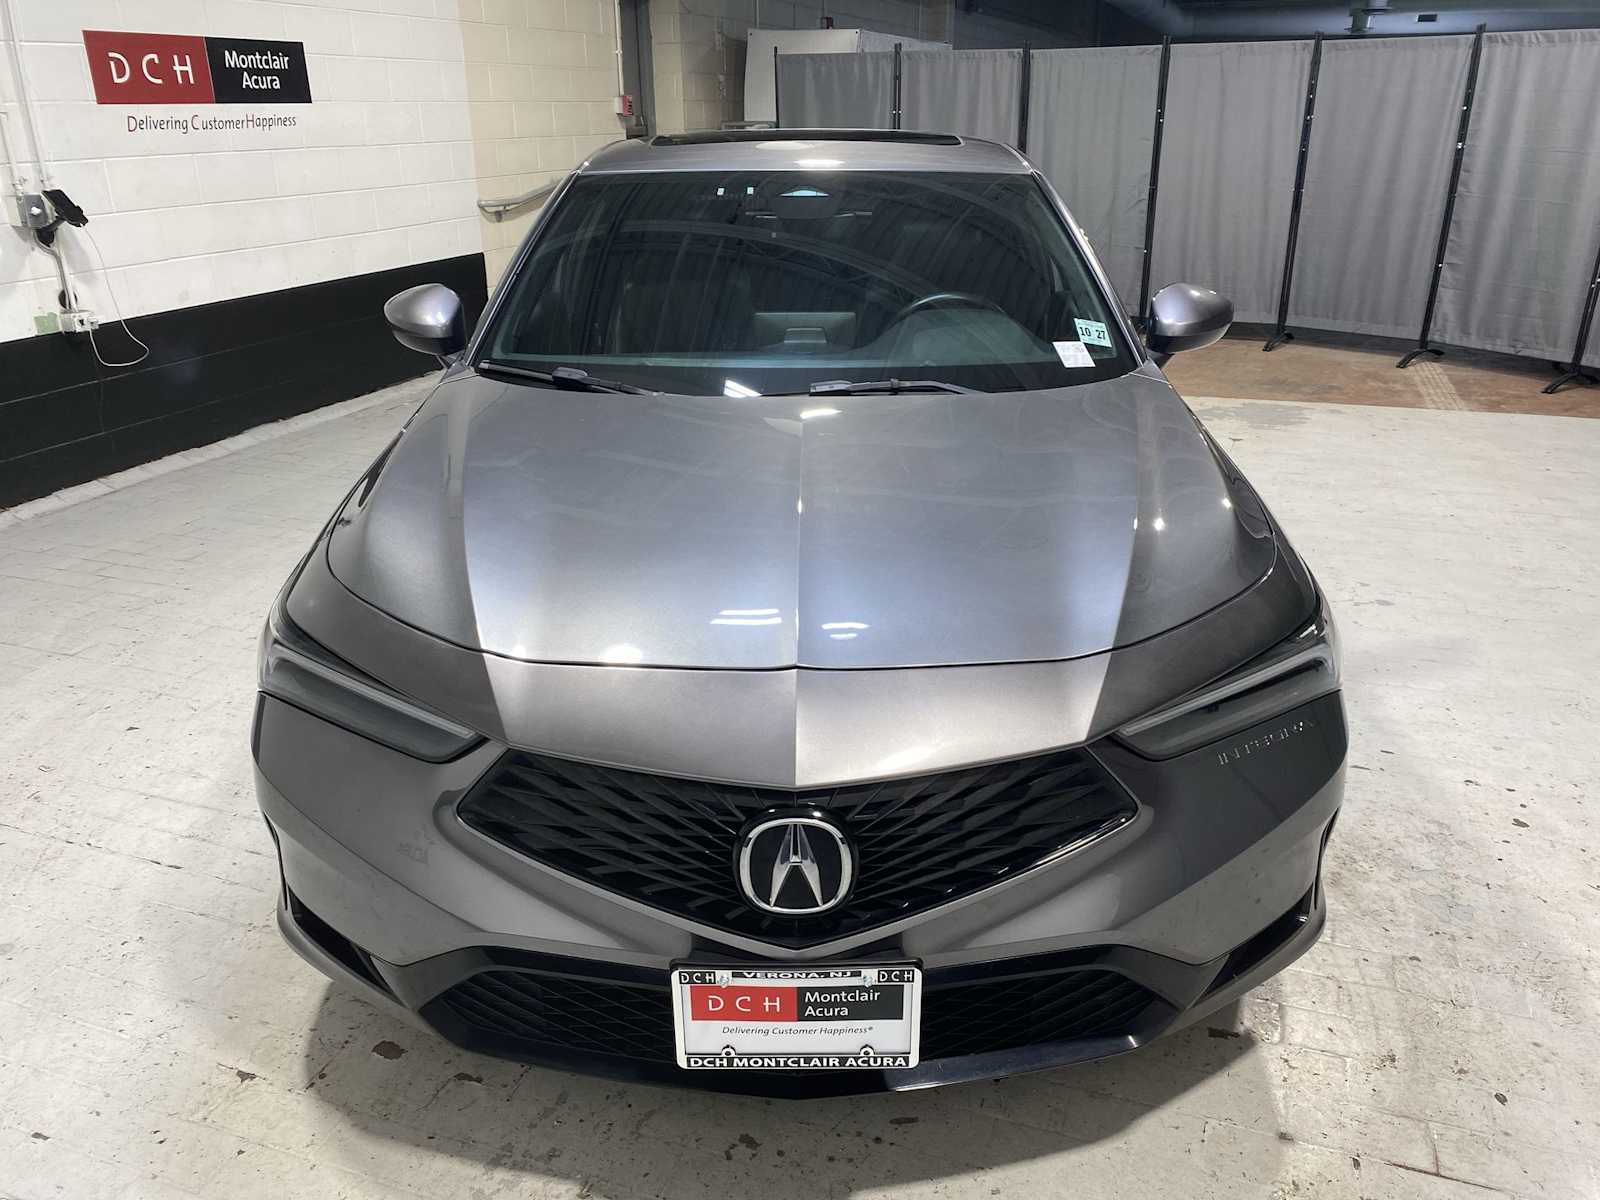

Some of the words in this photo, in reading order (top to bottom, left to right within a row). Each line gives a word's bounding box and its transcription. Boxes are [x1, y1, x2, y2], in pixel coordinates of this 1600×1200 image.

[224, 50, 289, 70] Montclair
[108, 52, 194, 84] DCH
[242, 71, 281, 89] Acura
[127, 115, 188, 134] Delivering
[1079, 327, 1091, 337] 10
[1096, 329, 1106, 340] 27
[680, 972, 715, 984] DCH
[879, 971, 914, 982] DCH
[804, 991, 881, 1003] Montclair
[708, 995, 781, 1013] DCH
[804, 1005, 849, 1018] Acura
[722, 1026, 769, 1036] Delivering
[772, 1027, 818, 1036] Customer
[690, 1057, 728, 1067] DCH
[733, 1057, 841, 1067] MONTCLAIR
[845, 1056, 907, 1067] ACURA
